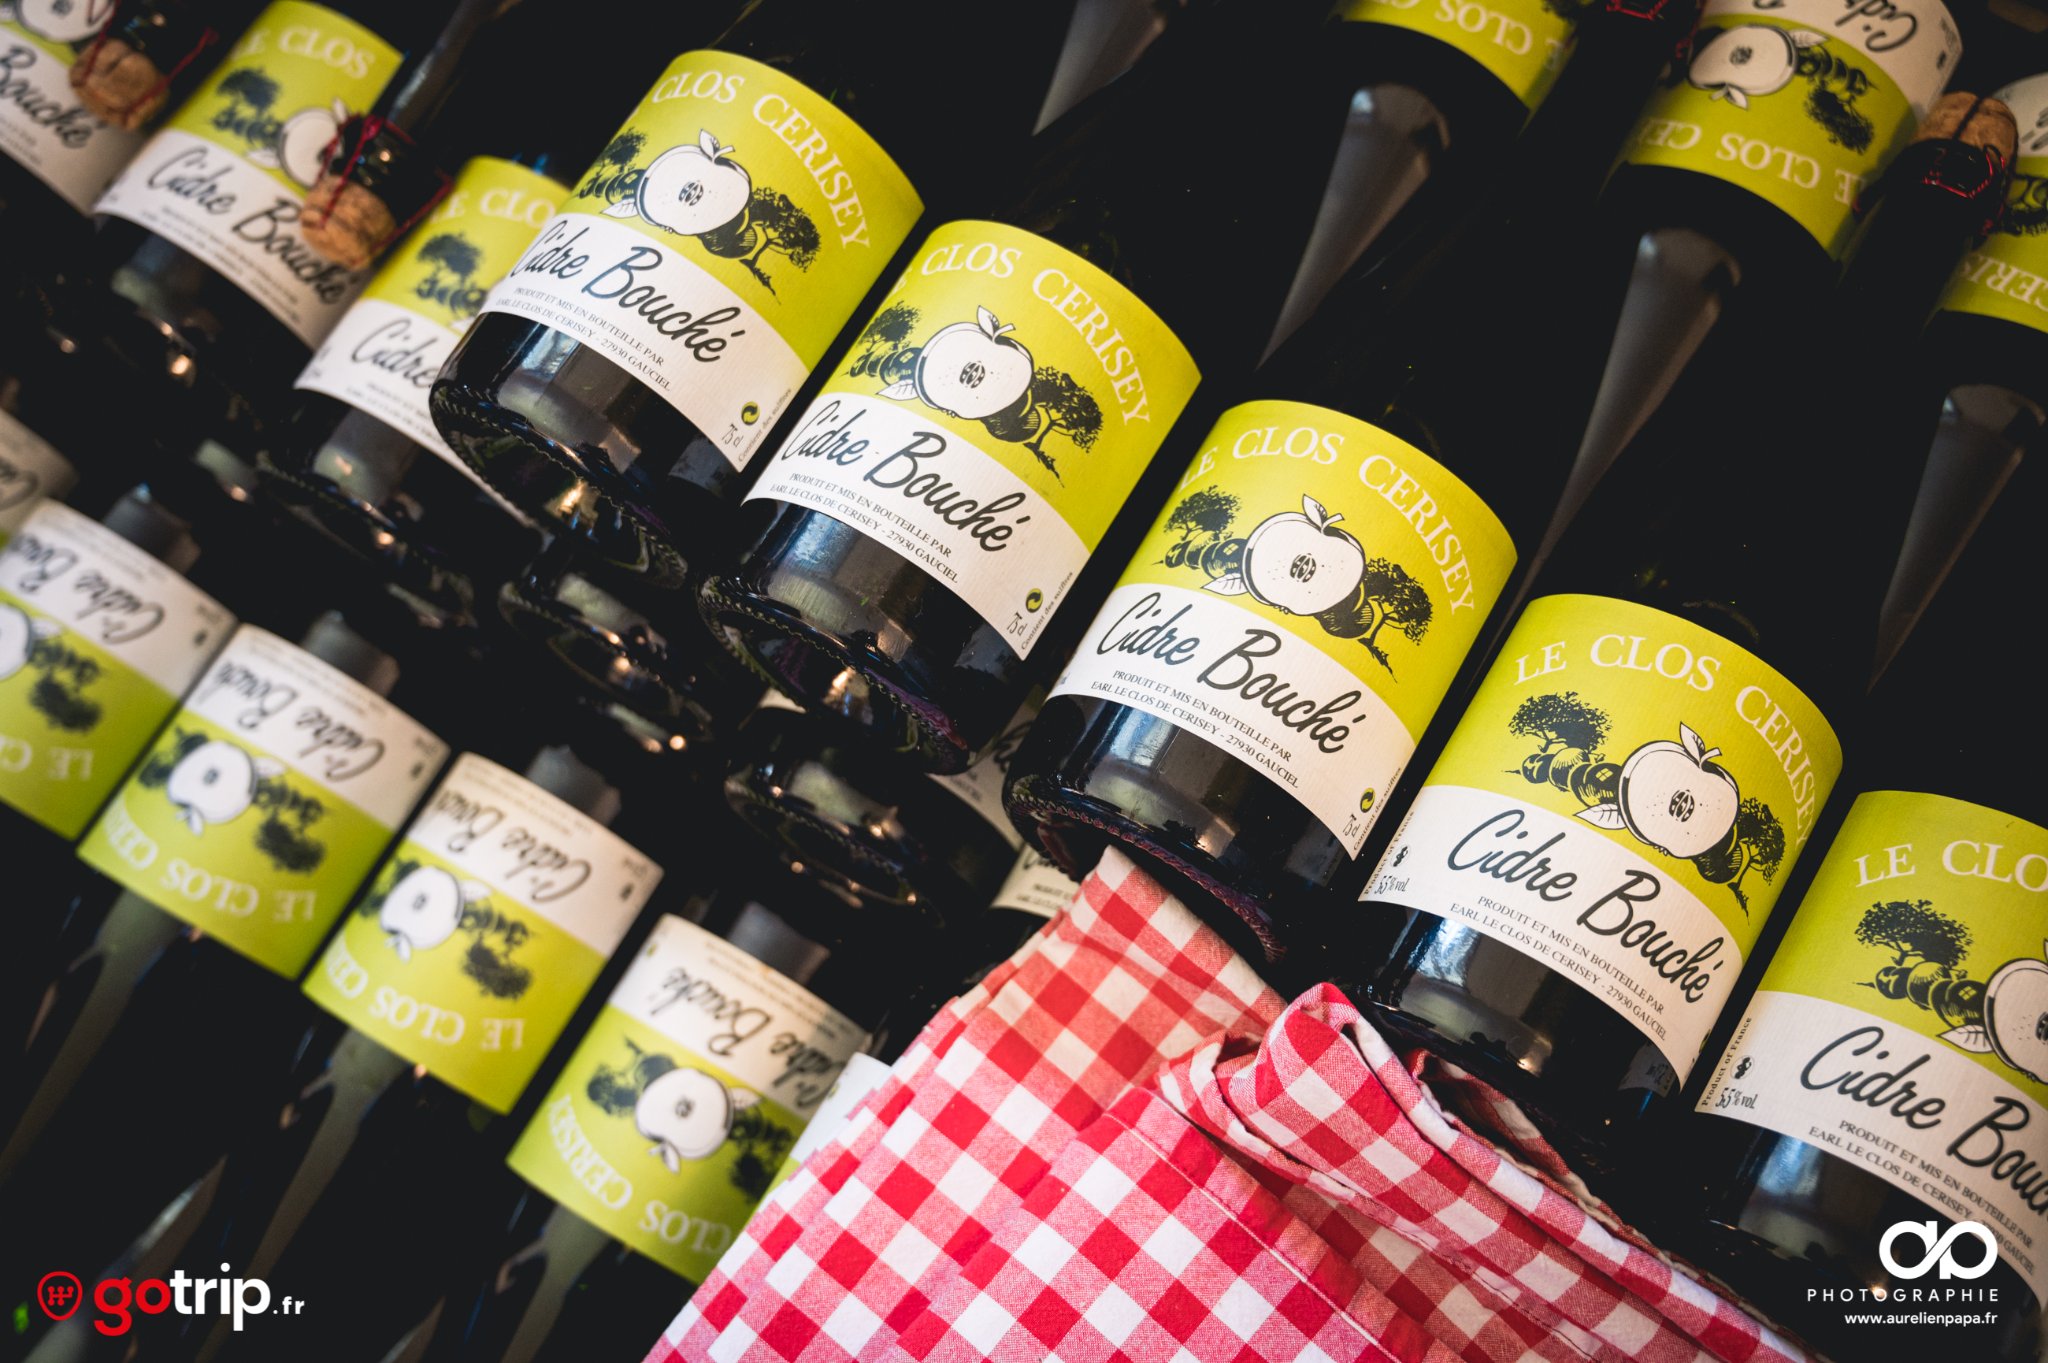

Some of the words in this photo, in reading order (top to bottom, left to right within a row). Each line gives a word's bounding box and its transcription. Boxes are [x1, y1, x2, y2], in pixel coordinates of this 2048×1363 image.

[278, 24, 376, 79] CLOS
[147, 145, 236, 215] Cidre
[652, 70, 745, 104] CLOS
[753, 93, 870, 249] CERISEY
[1715, 132, 1821, 190] CLOS
[510, 219, 590, 279] Cidre
[581, 246, 746, 363] Bouché
[514, 287, 545, 303] PRODUIT
[546, 293, 557, 304] ET
[557, 298, 574, 312] MIS
[573, 306, 590, 319] EN
[588, 313, 645, 351] BOUTEILLE
[643, 347, 665, 367] PAR
[921, 241, 1023, 278] CLOS
[1032, 268, 1151, 427] CERISEY
[521, 302, 542, 315] CLOS
[541, 308, 555, 320] DE
[555, 312, 596, 339] CERISEY
[600, 338, 628, 360] 27930
[627, 354, 673, 392] GAUCIEL
[781, 400, 868, 464] Cidre
[863, 430, 1031, 552] Bouché
[789, 472, 825, 489] PRODUIT
[825, 480, 836, 492] ET
[837, 484, 857, 501] MIS
[857, 494, 874, 509] EN
[873, 503, 930, 544] BOUTEILLE
[929, 538, 952, 558] PAR
[1180, 445, 1219, 492] LE
[1232, 425, 1345, 466] CLOS
[1358, 454, 1475, 617] CERISEY
[770, 483, 790, 495] EARL
[790, 486, 800, 496] LE
[799, 488, 823, 503] CLOS
[823, 495, 838, 508] DE
[837, 502, 883, 531] CERISEY
[886, 530, 915, 552] 27930
[914, 547, 959, 584] GAUCIEL
[1021, 616, 1045, 650] Contient
[1044, 601, 1055, 616] des
[1096, 592, 1201, 666] Cidre
[1196, 628, 1367, 754] Bouché
[1112, 669, 1154, 688] PRODUIT
[1155, 682, 1169, 694] ET
[1169, 686, 1194, 705] MIS
[1194, 698, 1210, 712] EN
[1209, 706, 1270, 748] BOUTEILLE
[1269, 742, 1292, 762] PAR
[1091, 680, 1113, 694] EARL
[1114, 686, 1128, 697] LE
[1127, 688, 1154, 706] CLOS
[1155, 698, 1172, 712] DE
[1172, 704, 1221, 736] CERISEY
[1225, 734, 1255, 758] 27930
[1255, 752, 1299, 789] GAUCIEL
[1512, 641, 1568, 687] LE
[1590, 633, 1723, 692] CLOS
[1735, 684, 1815, 846] CERISEY
[502, 827, 592, 903] Cidre
[1353, 815, 1376, 851] Contient
[1854, 843, 1917, 888] LE
[160, 857, 259, 917] CLOS
[1446, 808, 1578, 902] Cidre
[1576, 868, 1724, 1005] Bouché
[1450, 902, 1481, 922] EARL
[1482, 914, 1499, 928] LE
[1499, 920, 1532, 945] CLOS
[1532, 938, 1551, 956] DE
[1551, 946, 1603, 985] CERISEY
[1606, 984, 1633, 1010] 27930
[1632, 1004, 1668, 1042] GAUCIEL
[1477, 896, 1531, 926] PRODUIT
[1531, 920, 1549, 934] ET
[1549, 928, 1576, 948] MIS
[1572, 944, 1591, 960] EN
[1589, 952, 1648, 1001] BOUTEILLE
[1646, 995, 1665, 1016] PAR
[369, 986, 465, 1045] CLOS
[481, 1017, 526, 1051] LE
[649, 966, 772, 1057] Bouché
[1701, 1067, 1726, 1106] Product
[1725, 1052, 1734, 1064] of
[1730, 1017, 1752, 1050] France
[1800, 1026, 1947, 1131] Cidre
[1808, 1126, 1844, 1148] EARL
[1845, 1140, 1865, 1157] LE
[1865, 1149, 1901, 1176] CLOS
[1902, 1170, 1921, 1188] DE
[1922, 1179, 1973, 1219] CERISEY
[1839, 1119, 1900, 1154] PRODUIT
[1899, 1147, 1919, 1165] ET
[1918, 1158, 1943, 1179] MIS
[1943, 1173, 1962, 1191] EN
[1961, 1186, 2018, 1234] BOUTEILLE
[2015, 1227, 2033, 1249] PAR
